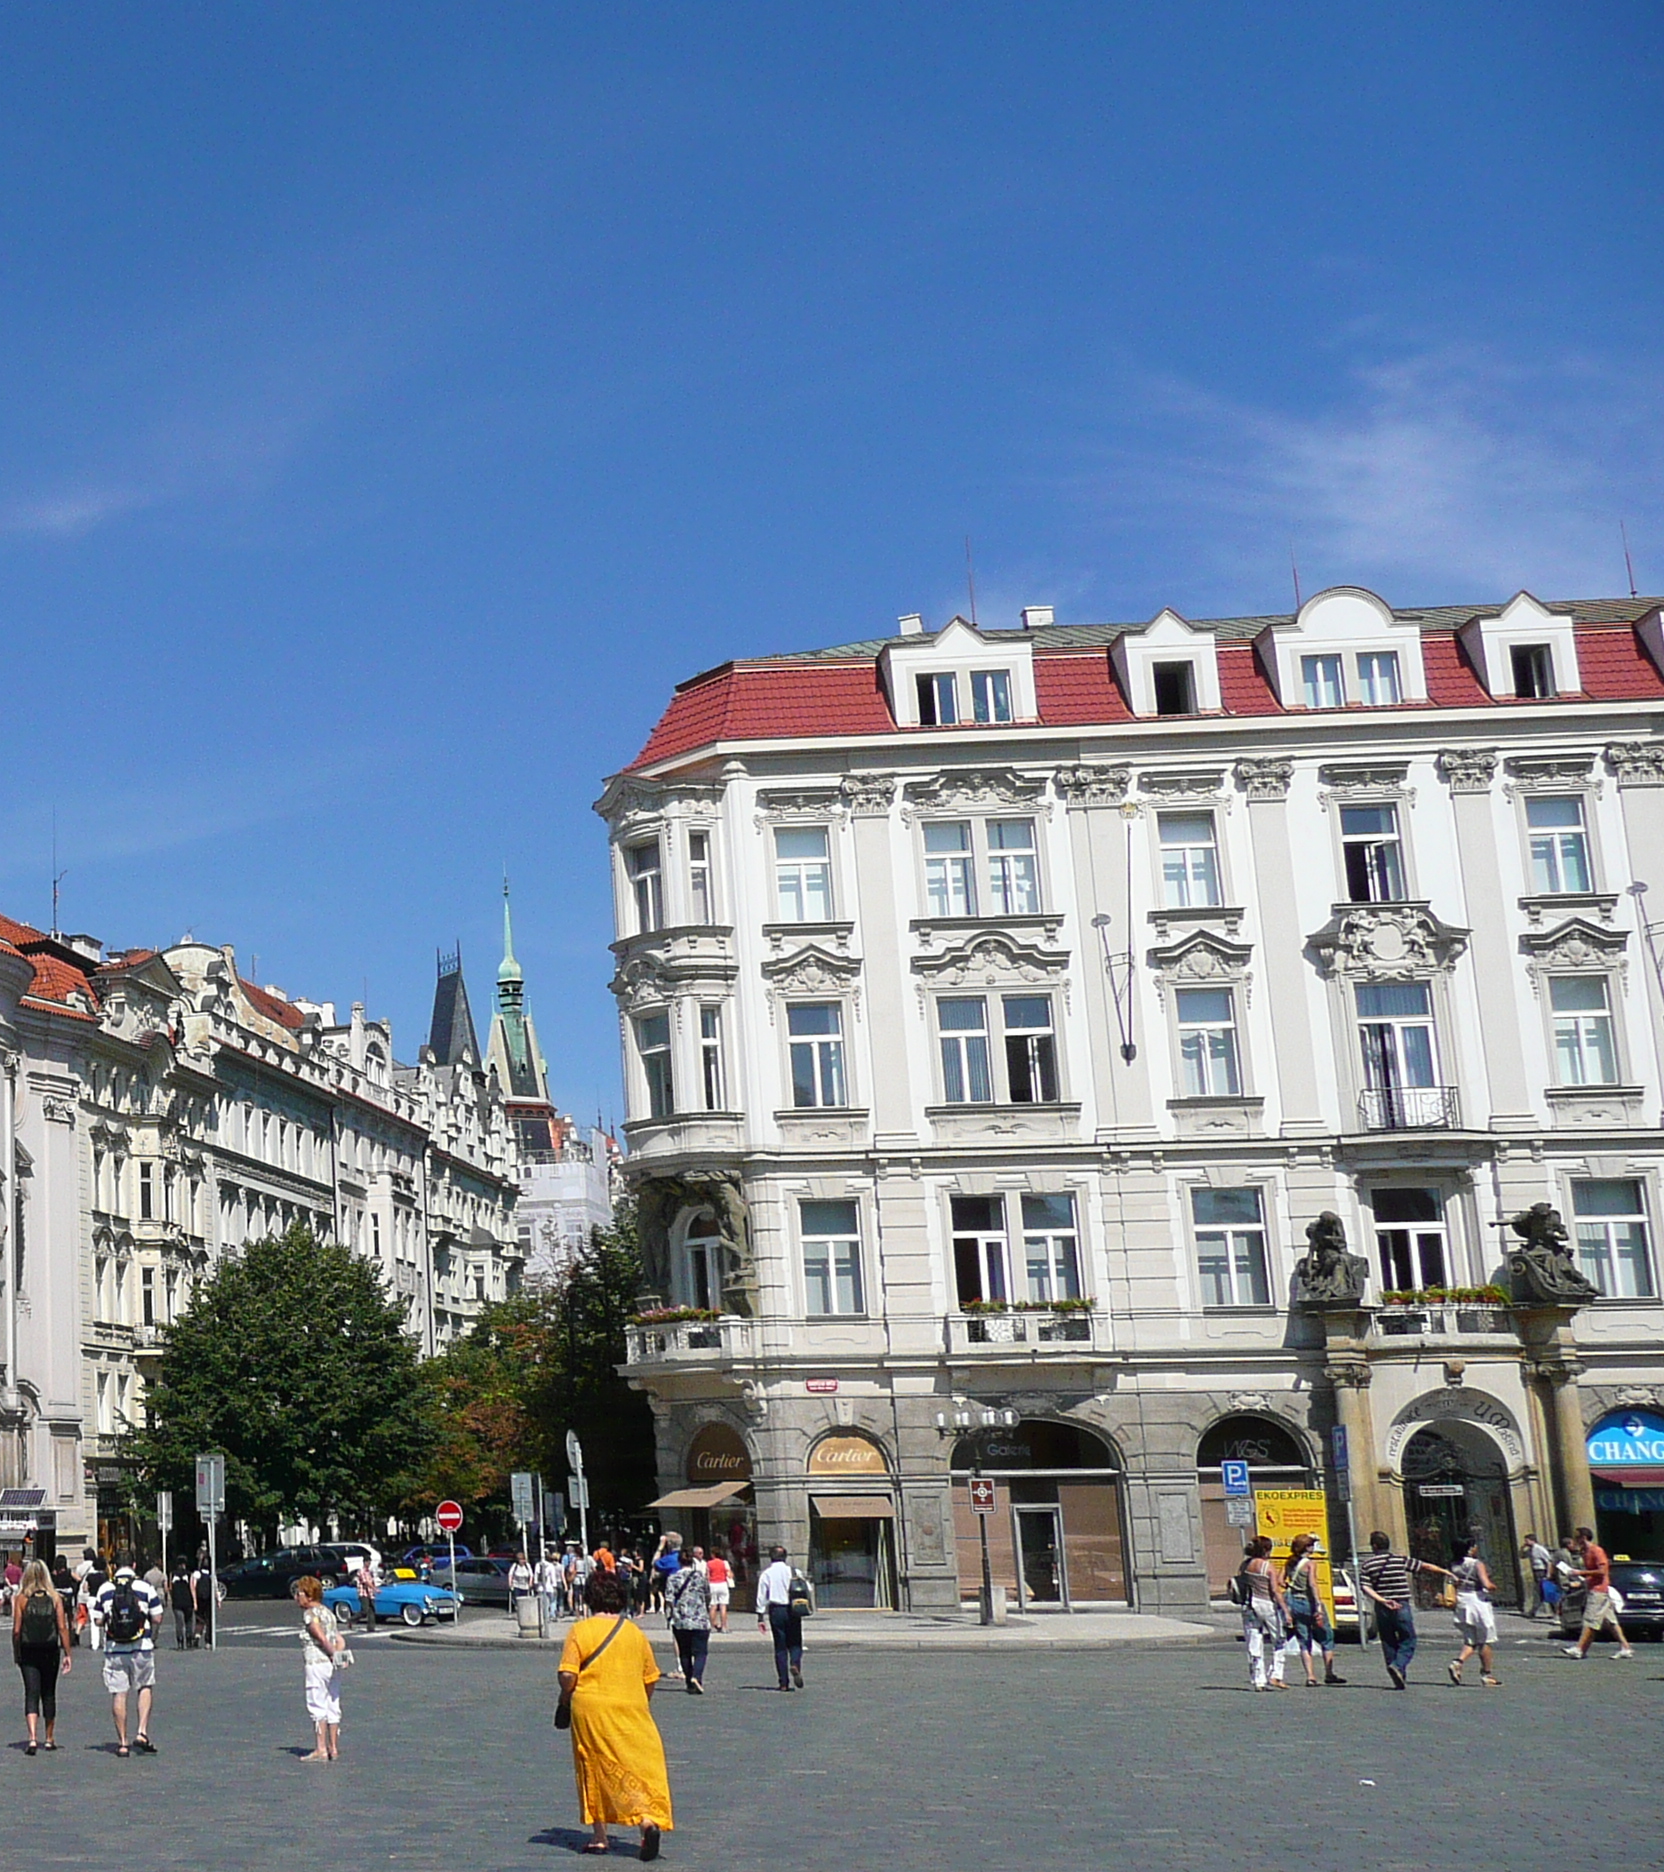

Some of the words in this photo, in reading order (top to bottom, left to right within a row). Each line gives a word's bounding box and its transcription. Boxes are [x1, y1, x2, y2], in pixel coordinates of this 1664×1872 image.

[816, 1447, 877, 1463] Cartier
[1588, 1440, 1664, 1461] CHANG
[696, 1451, 744, 1469] Cartier
[1227, 1465, 1242, 1485] P
[1256, 1491, 1324, 1501] EKOEXPRES
